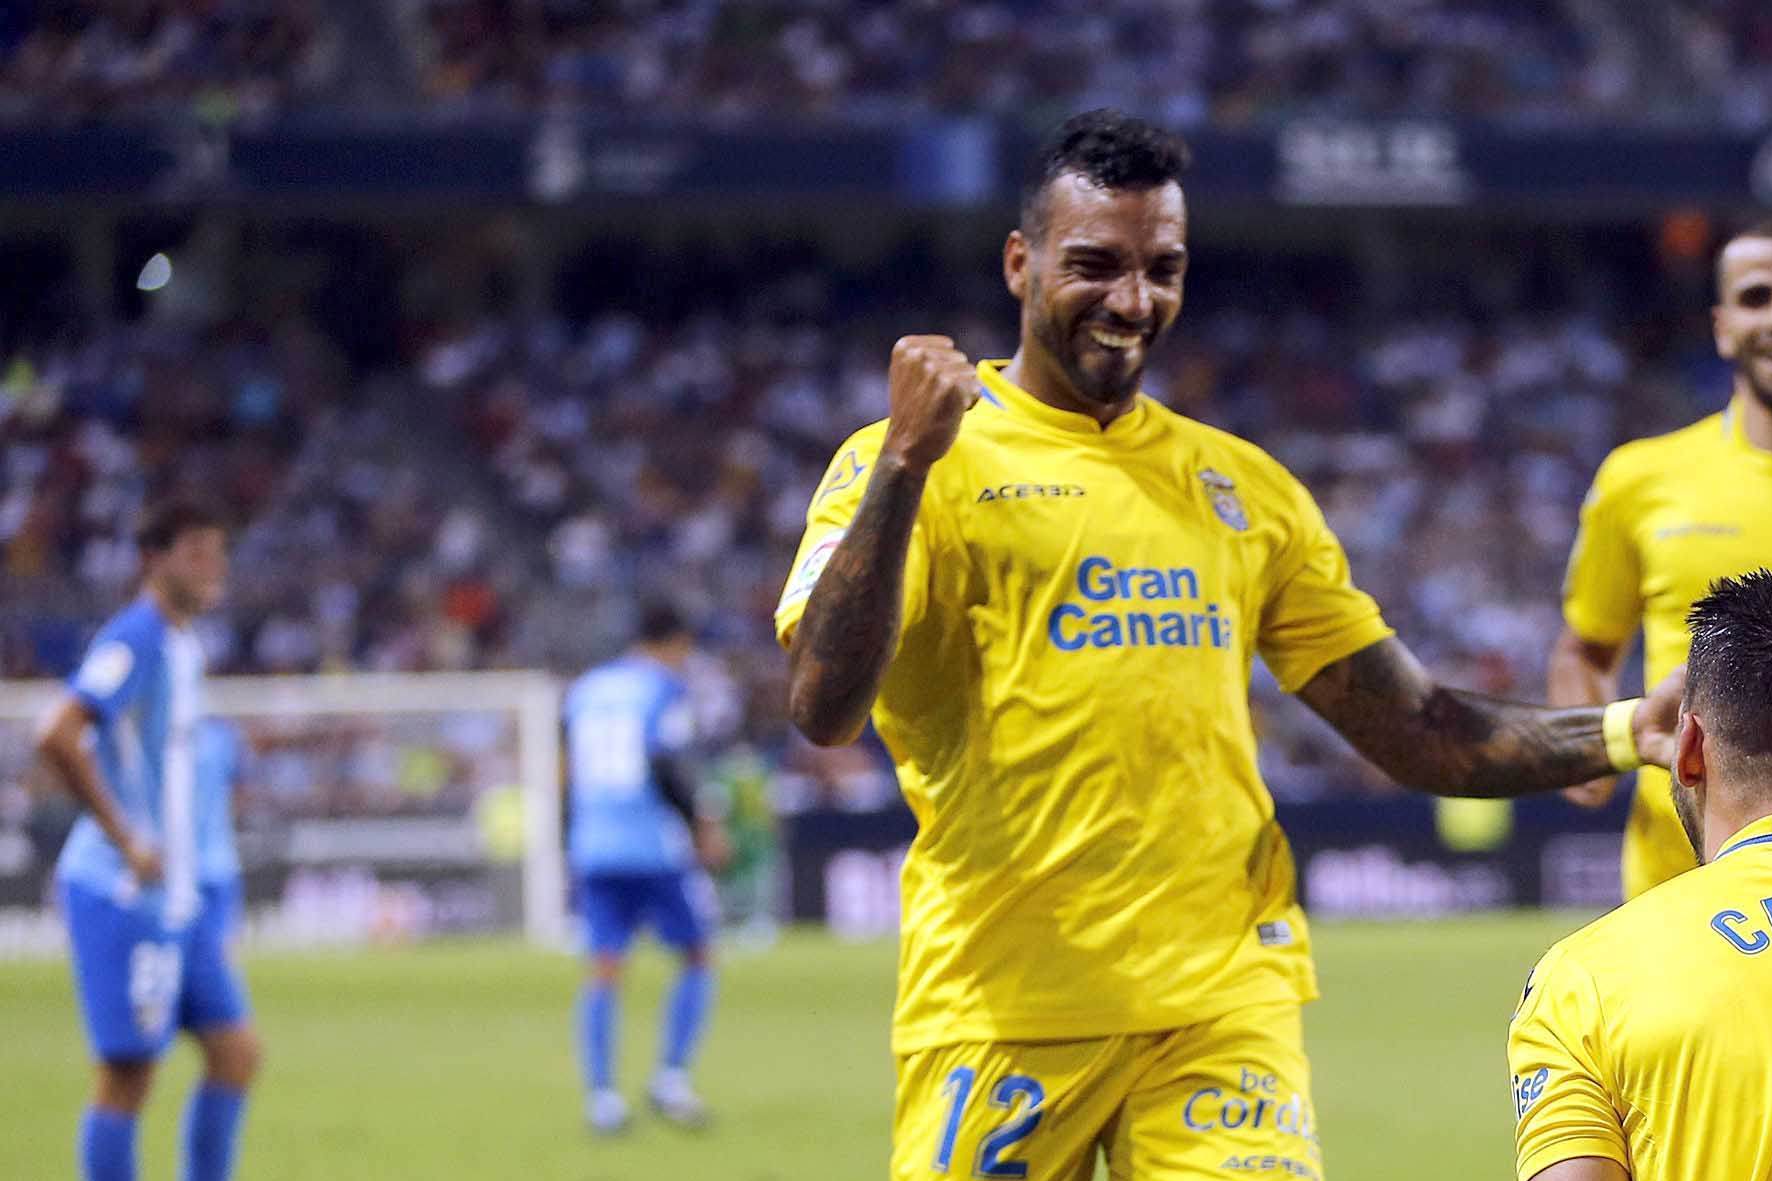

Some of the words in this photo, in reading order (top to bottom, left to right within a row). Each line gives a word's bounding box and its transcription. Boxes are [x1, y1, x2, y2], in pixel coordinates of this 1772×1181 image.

[1077, 555, 1199, 601] Gran
[1240, 1066, 1278, 1094] be
[929, 1064, 1046, 1181] 12
